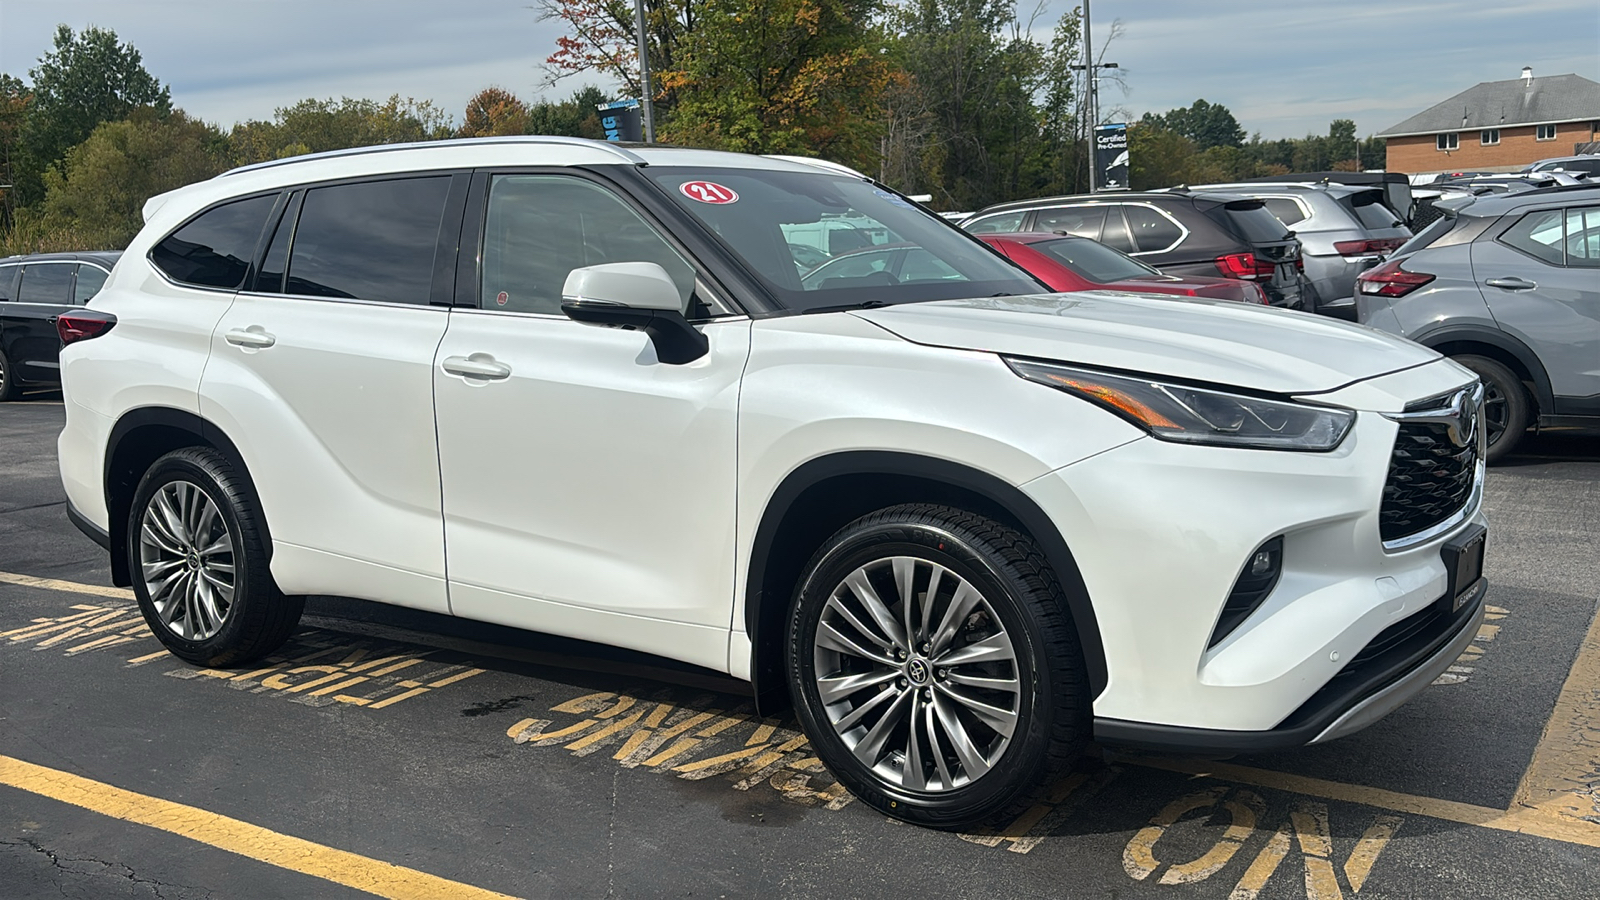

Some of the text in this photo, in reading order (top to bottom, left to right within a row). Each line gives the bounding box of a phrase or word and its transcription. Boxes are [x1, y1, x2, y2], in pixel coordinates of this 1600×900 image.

[1097, 134, 1127, 143] Certified
[1097, 142, 1127, 150] Pre-Owned
[691, 183, 728, 201] 21
[1121, 786, 1405, 900] NO
